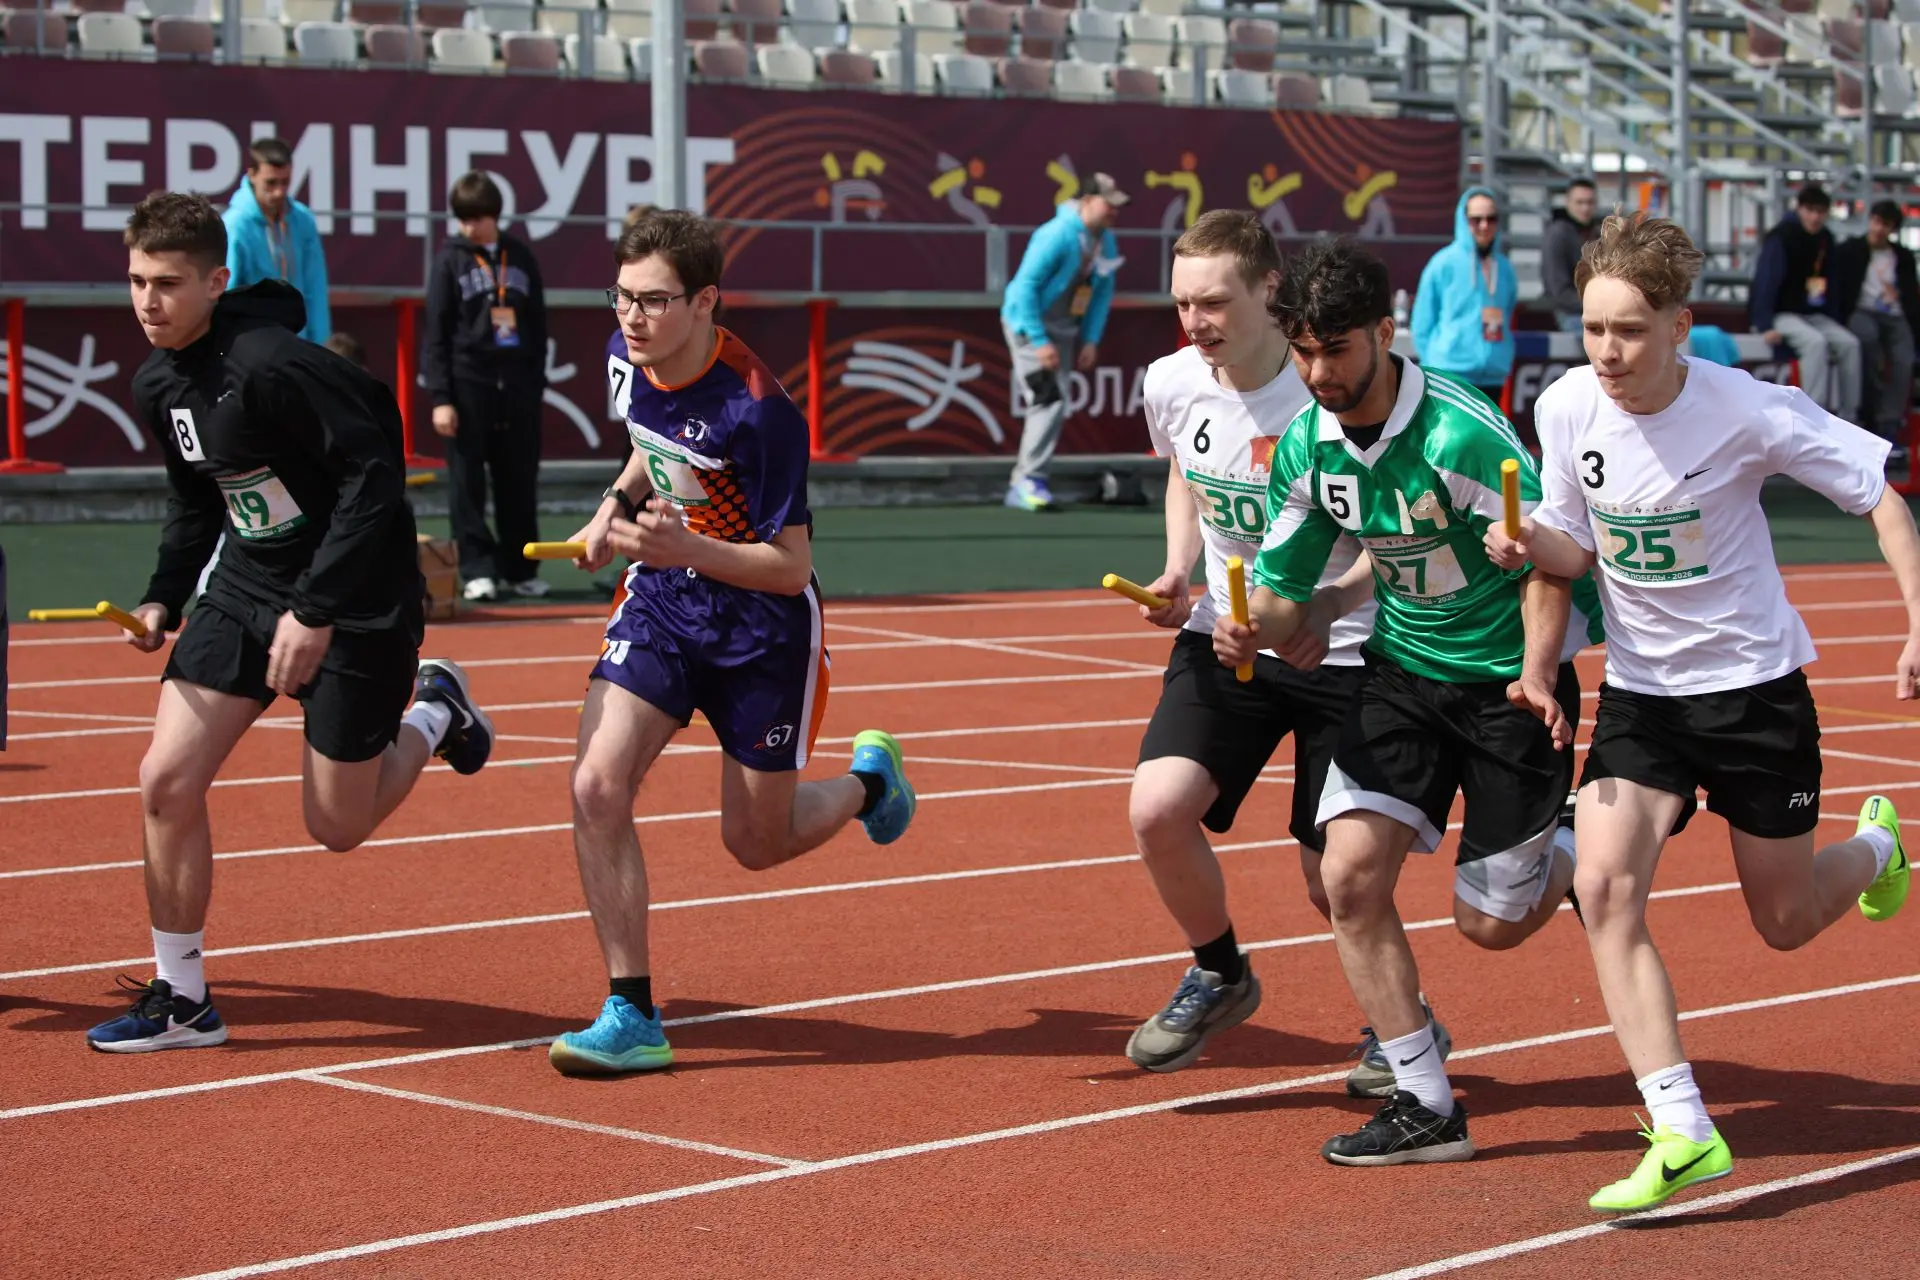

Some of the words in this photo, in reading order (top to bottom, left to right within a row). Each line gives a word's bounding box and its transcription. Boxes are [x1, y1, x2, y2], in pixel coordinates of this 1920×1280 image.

[612, 366, 626, 402] 7
[176, 418, 194, 452] 8
[1193, 418, 1211, 454] 6
[648, 454, 673, 492] 6
[1581, 450, 1605, 489] 3
[228, 490, 270, 528] 49
[1205, 489, 1265, 533] 30
[1327, 483, 1351, 520] 5
[1608, 528, 1676, 570] 25
[1377, 557, 1427, 594] 27
[1631, 573, 1666, 582] ПОБЕДЫ
[1673, 571, 1693, 579] 2026
[765, 724, 793, 747] 67
